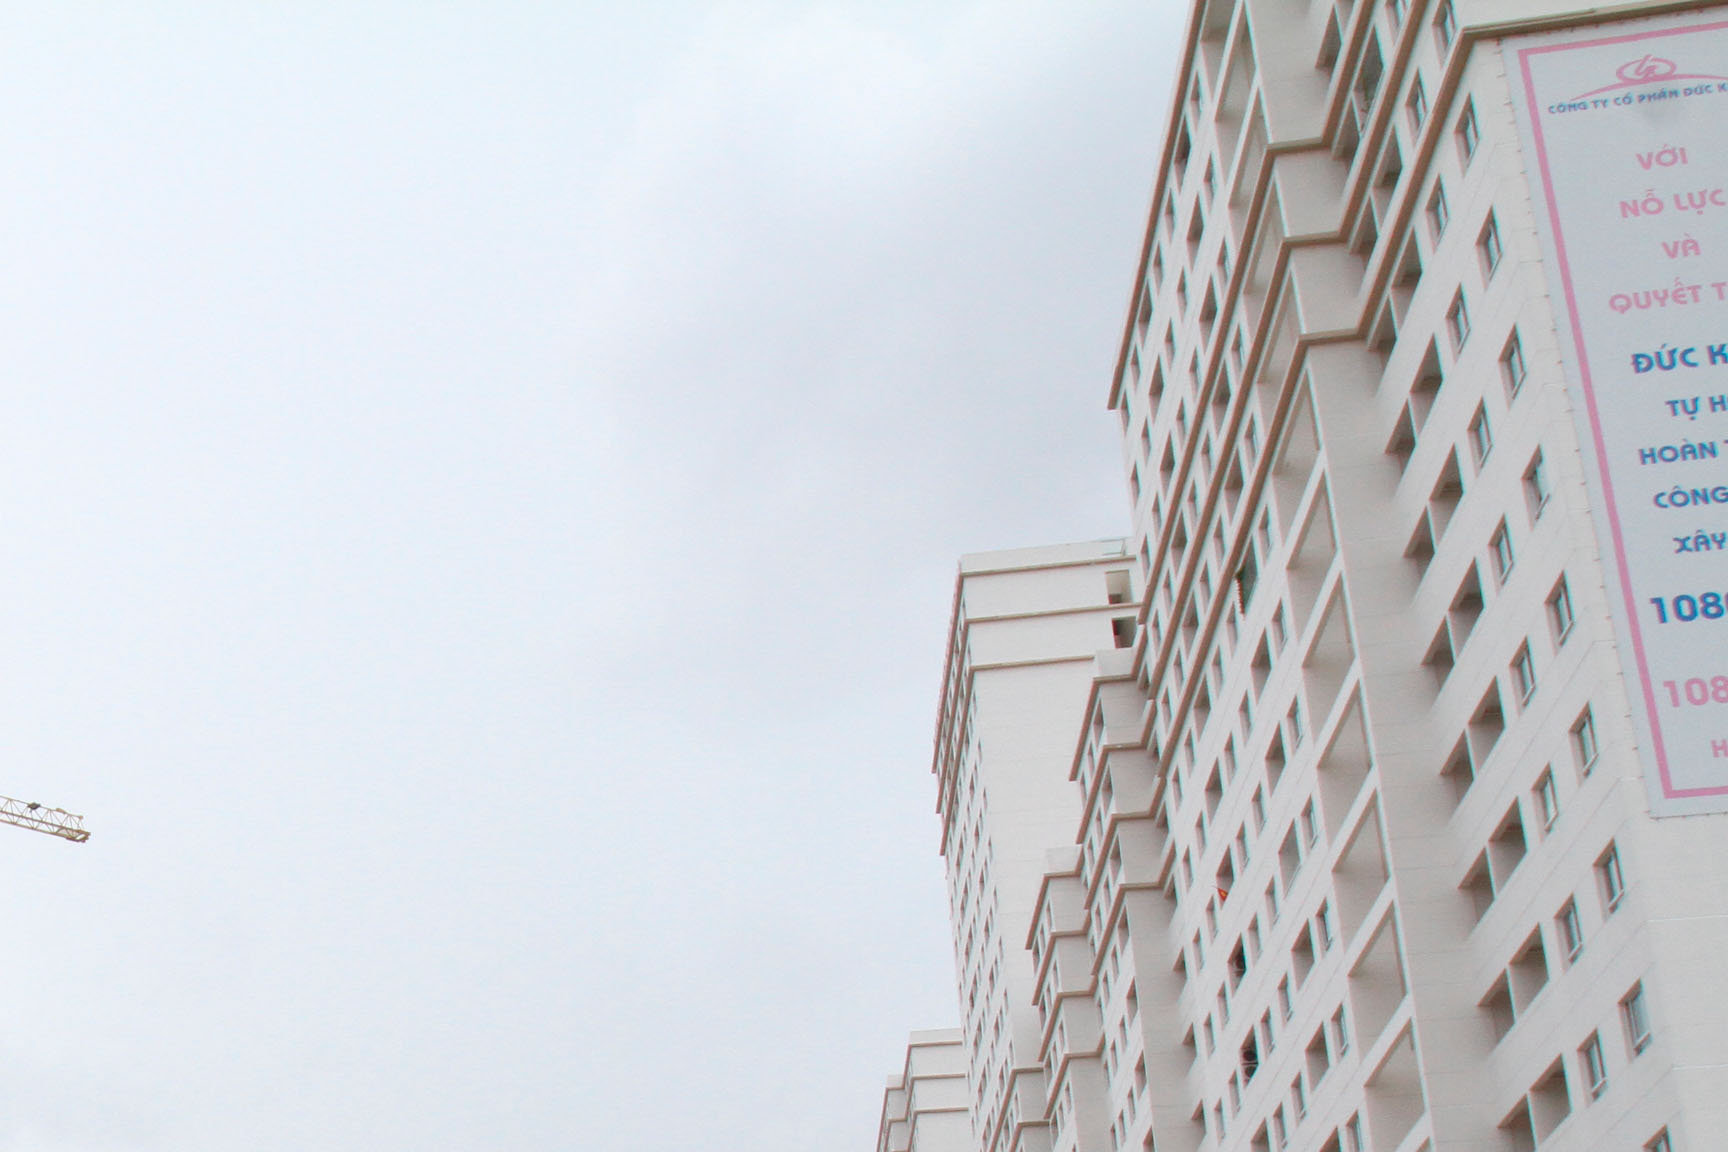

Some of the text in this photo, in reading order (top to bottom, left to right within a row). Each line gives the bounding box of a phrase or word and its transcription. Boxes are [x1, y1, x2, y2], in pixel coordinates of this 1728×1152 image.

[1592, 98, 1609, 109] TY
[1636, 144, 1688, 170] VỚI
[1619, 188, 1727, 218] NỖ LỰC
[1661, 232, 1701, 259] VÀ
[1609, 276, 1702, 314] QUYẾT
[1630, 343, 1700, 374] ĐỨC
[1665, 396, 1700, 421] TỰ
[1638, 438, 1718, 465] HOÀN
[1653, 485, 1728, 508] CÔNG
[1673, 529, 1727, 554] XÂY
[1649, 591, 1728, 624] 108
